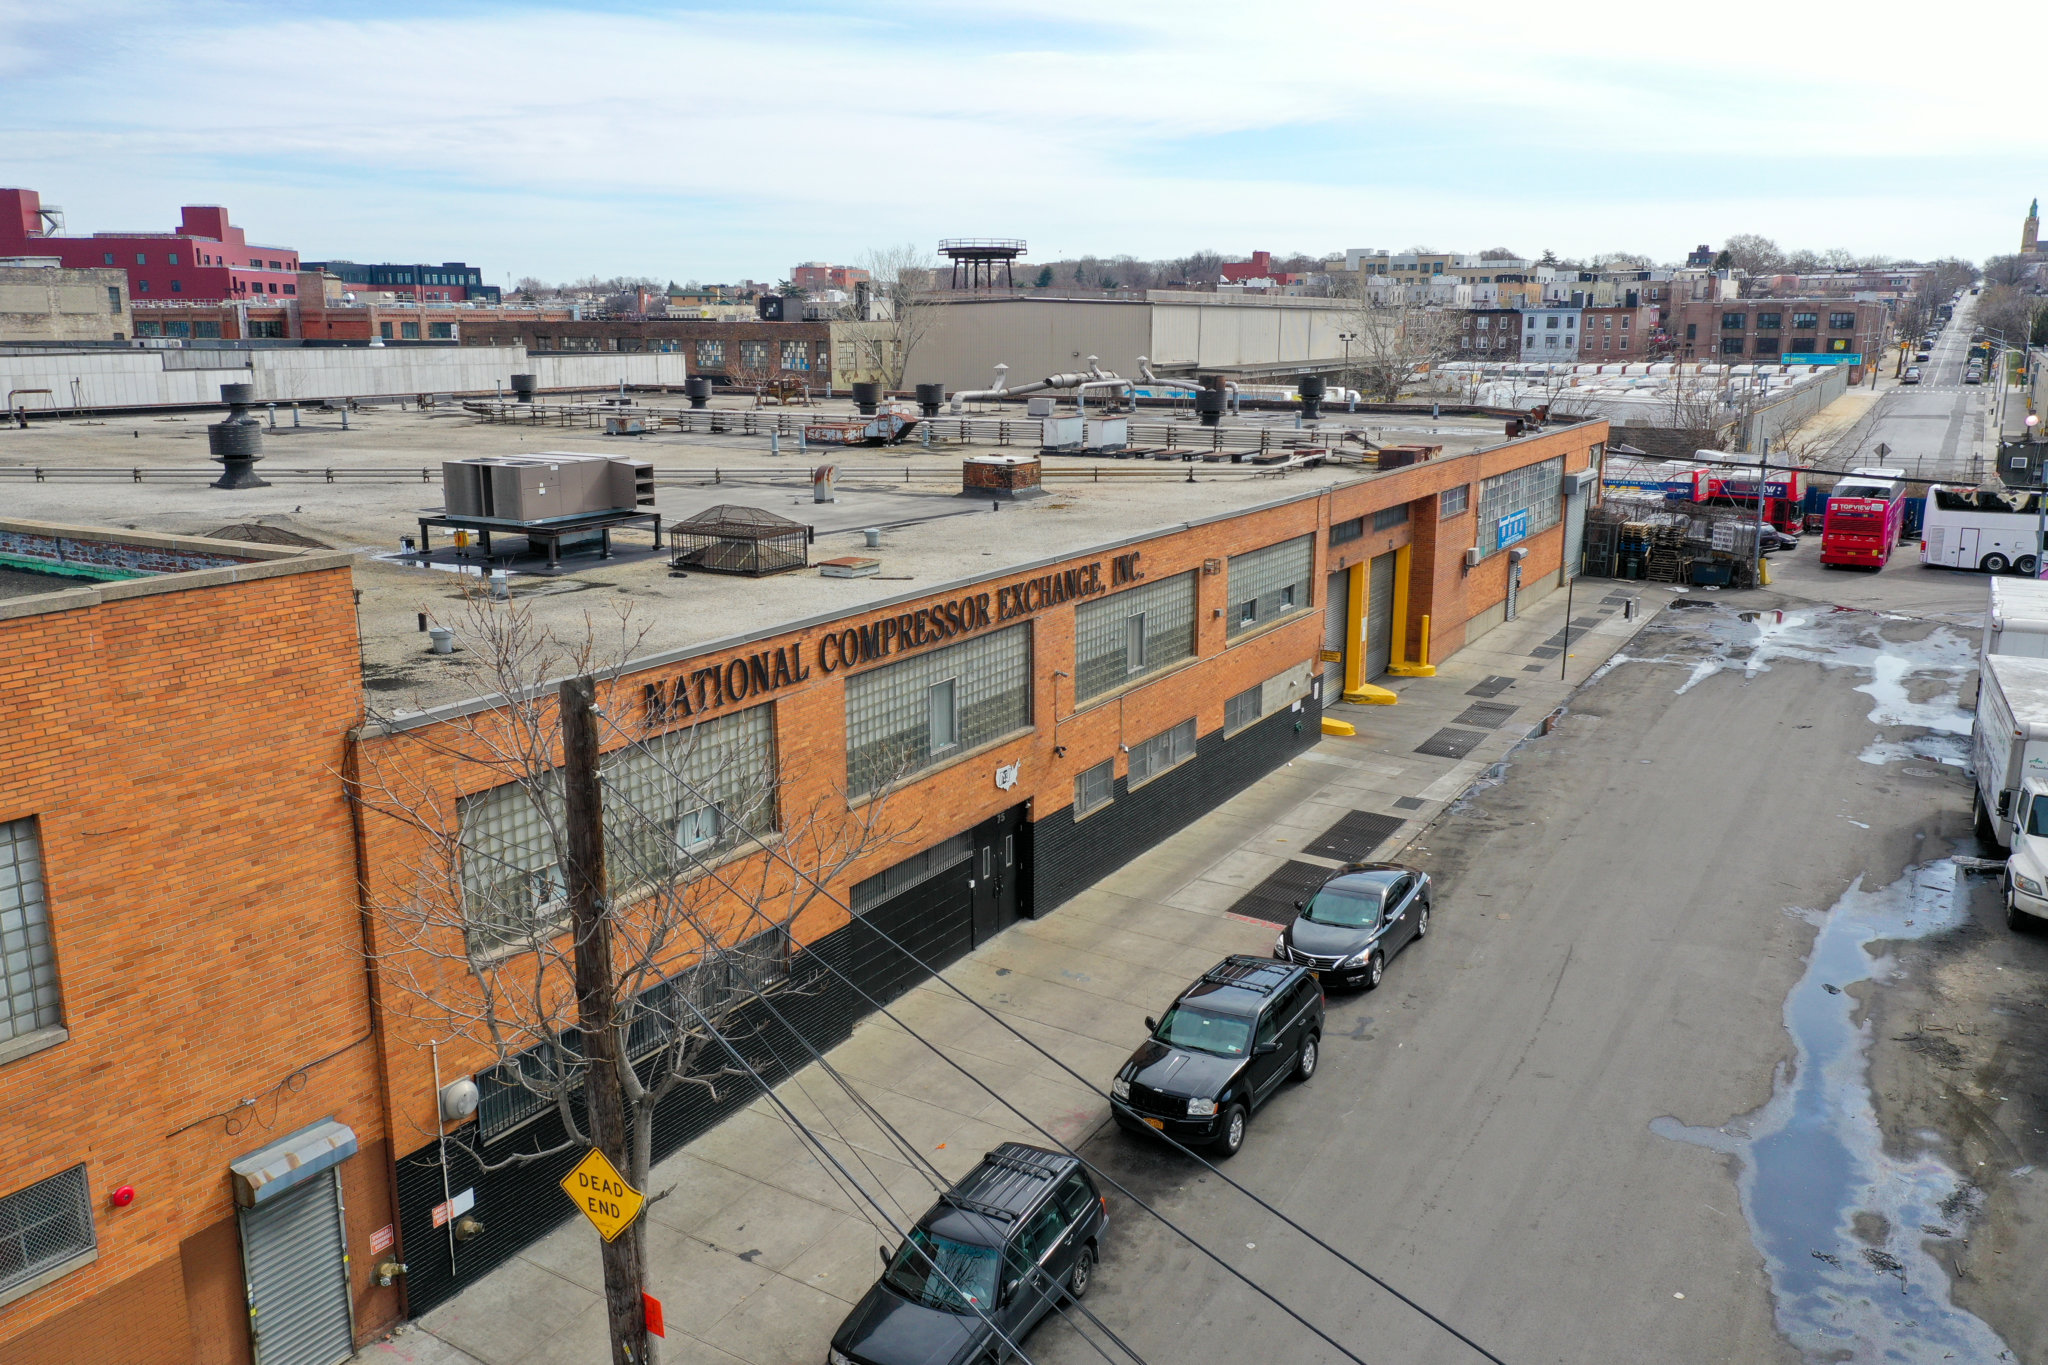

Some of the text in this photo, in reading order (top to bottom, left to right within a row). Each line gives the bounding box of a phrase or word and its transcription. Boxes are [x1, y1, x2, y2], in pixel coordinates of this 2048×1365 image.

[1840, 503, 1872, 511] TOPVIEW
[644, 551, 1145, 728] NATIONAL COMPRESSOR EXCHANGE, INC.
[578, 1172, 624, 1198] DEAD
[588, 1197, 620, 1219] END
